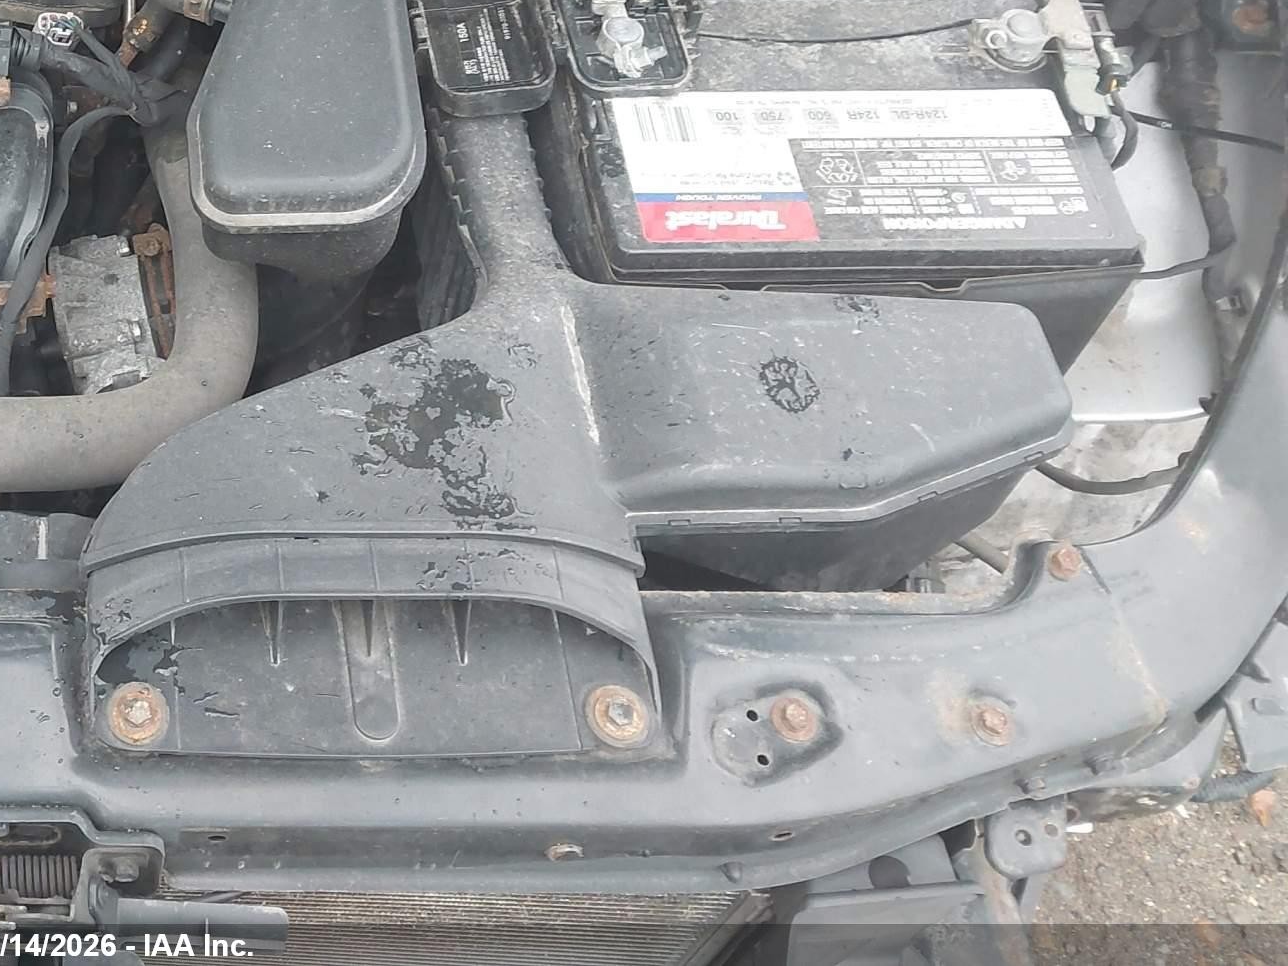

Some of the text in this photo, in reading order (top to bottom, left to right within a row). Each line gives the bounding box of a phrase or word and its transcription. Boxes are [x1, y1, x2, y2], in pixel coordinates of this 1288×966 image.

[716, 111, 740, 122] 100
[759, 110, 785, 121] 750
[846, 110, 880, 121] 124R
[665, 210, 787, 231] Duralast
